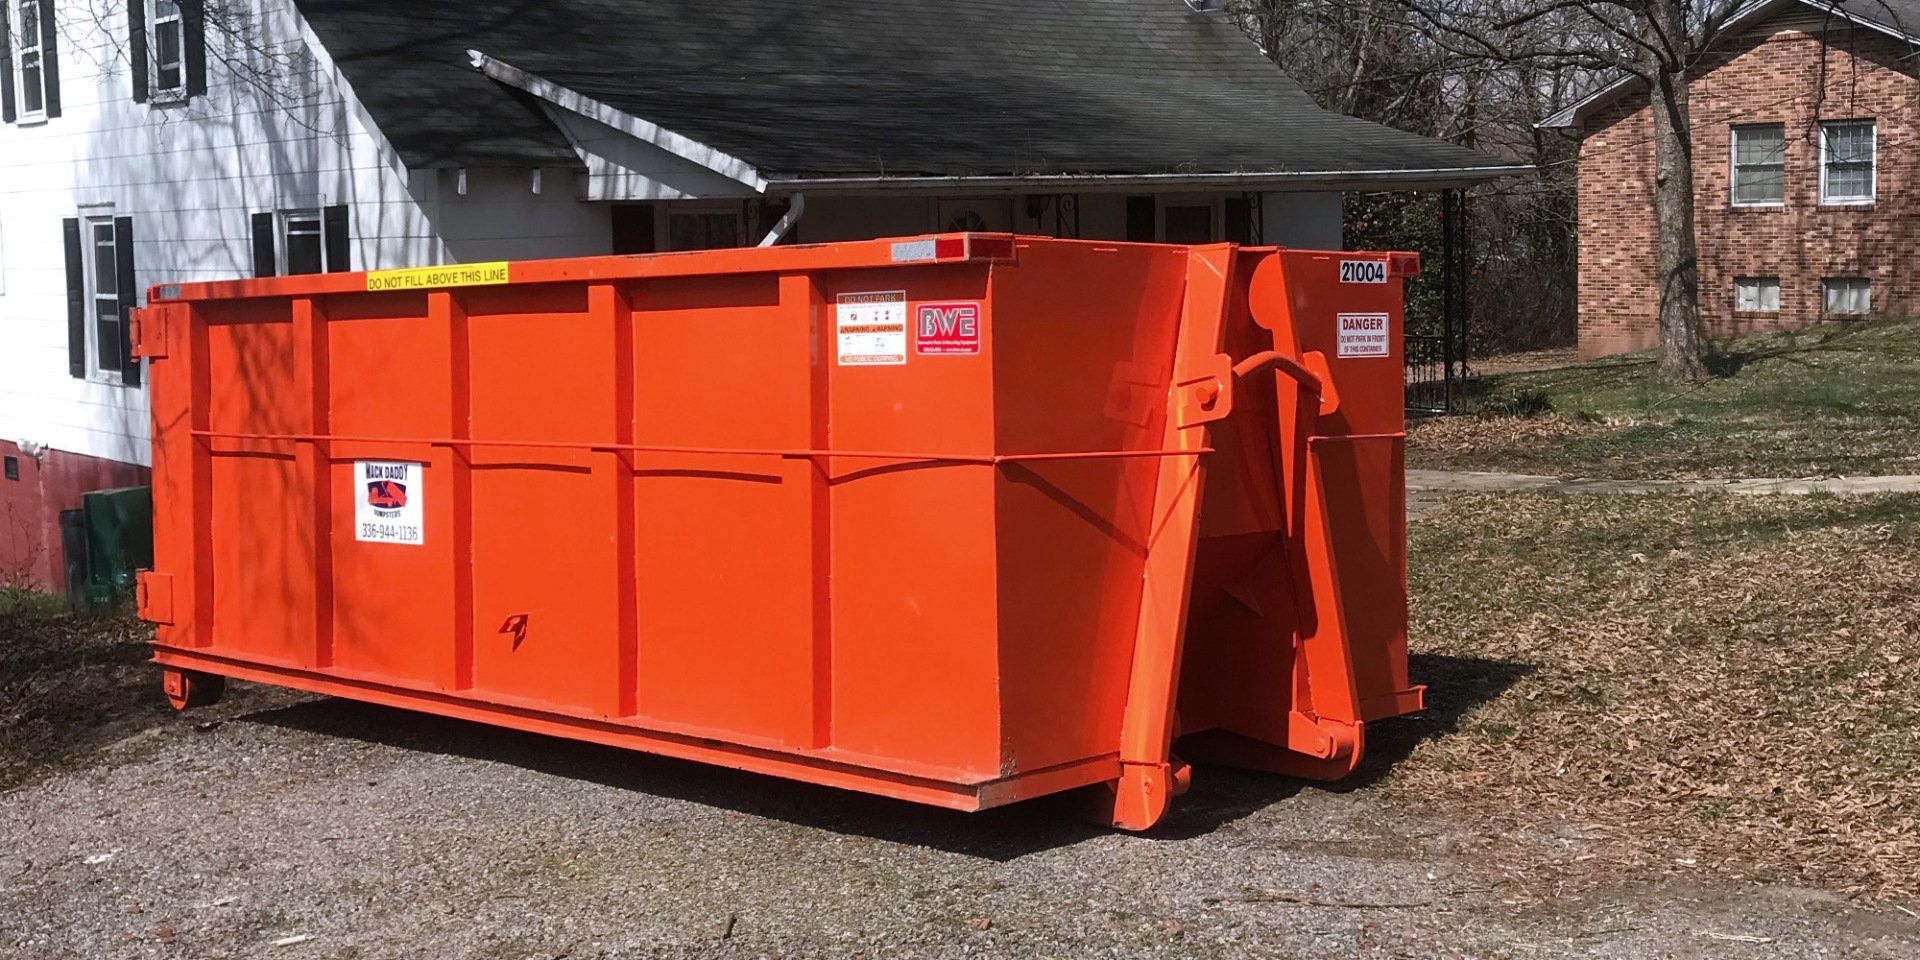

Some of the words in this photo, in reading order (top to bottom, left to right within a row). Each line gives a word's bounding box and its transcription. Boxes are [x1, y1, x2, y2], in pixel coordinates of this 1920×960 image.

[369, 278, 382, 289] DO
[384, 276, 402, 288] NOT
[405, 275, 424, 286] FILL
[426, 272, 458, 284] ABOVE
[461, 270, 482, 282] THIS
[484, 268, 506, 280] LINE
[1342, 262, 1384, 282] 21004
[857, 295, 874, 303] NOT
[875, 294, 896, 302] PARK
[920, 307, 975, 337] BWE
[1342, 318, 1383, 330] DANGER
[1341, 335, 1346, 343] DO
[1347, 335, 1355, 343] NOT
[1356, 335, 1366, 343] PARK
[366, 462, 384, 479] MACK
[385, 464, 408, 481] DADDY
[374, 509, 401, 518] DUMPSTERS
[363, 523, 418, 541] 336-944-1136
